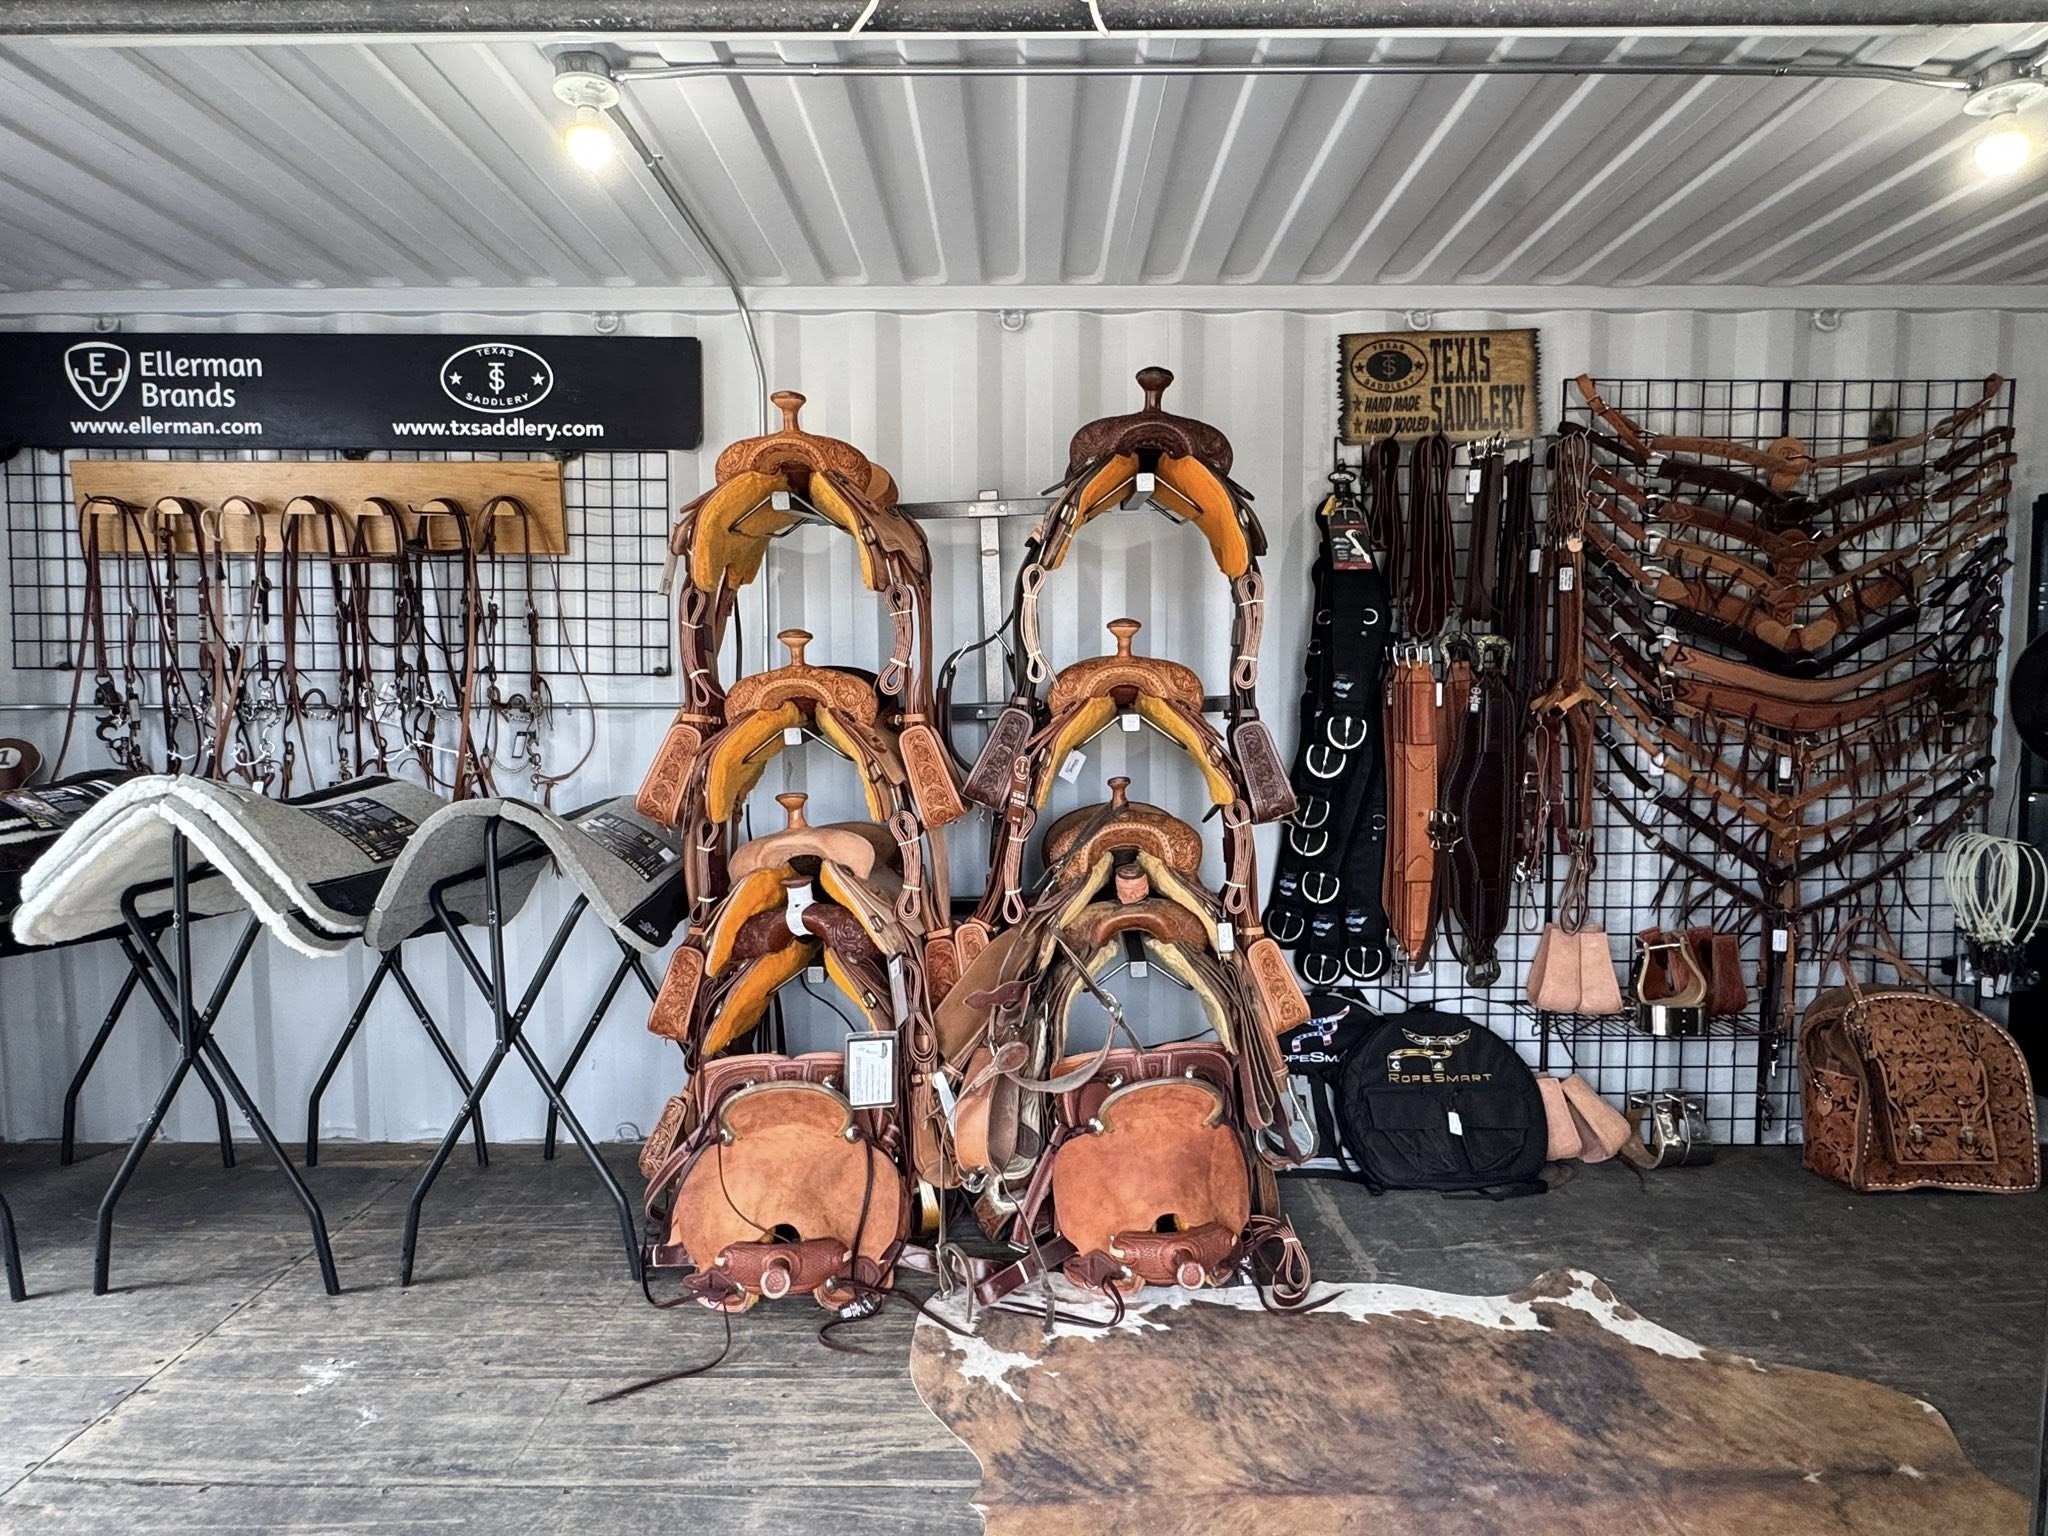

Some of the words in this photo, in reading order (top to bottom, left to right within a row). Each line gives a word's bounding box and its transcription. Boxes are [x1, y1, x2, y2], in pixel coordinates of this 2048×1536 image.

[476, 347, 515, 358] TEXAS
[1372, 342, 1406, 351] TEXAS
[140, 351, 263, 377] Ellerman
[1429, 337, 1491, 385] TEXAS
[1364, 375, 1415, 391] SADDLERY
[142, 382, 236, 408] Brands
[465, 392, 530, 406] SADDLERY
[1364, 396, 1392, 413] HAND
[1392, 395, 1422, 412] MADE
[1430, 385, 1525, 432] SADDLERY
[70, 416, 263, 435] www.ellerman.com
[392, 418, 605, 441] www.txsaddlery.com
[1364, 417, 1393, 434] HAND
[1394, 416, 1430, 433] TOOLED
[1388, 1073, 1493, 1084] ROPESMART
